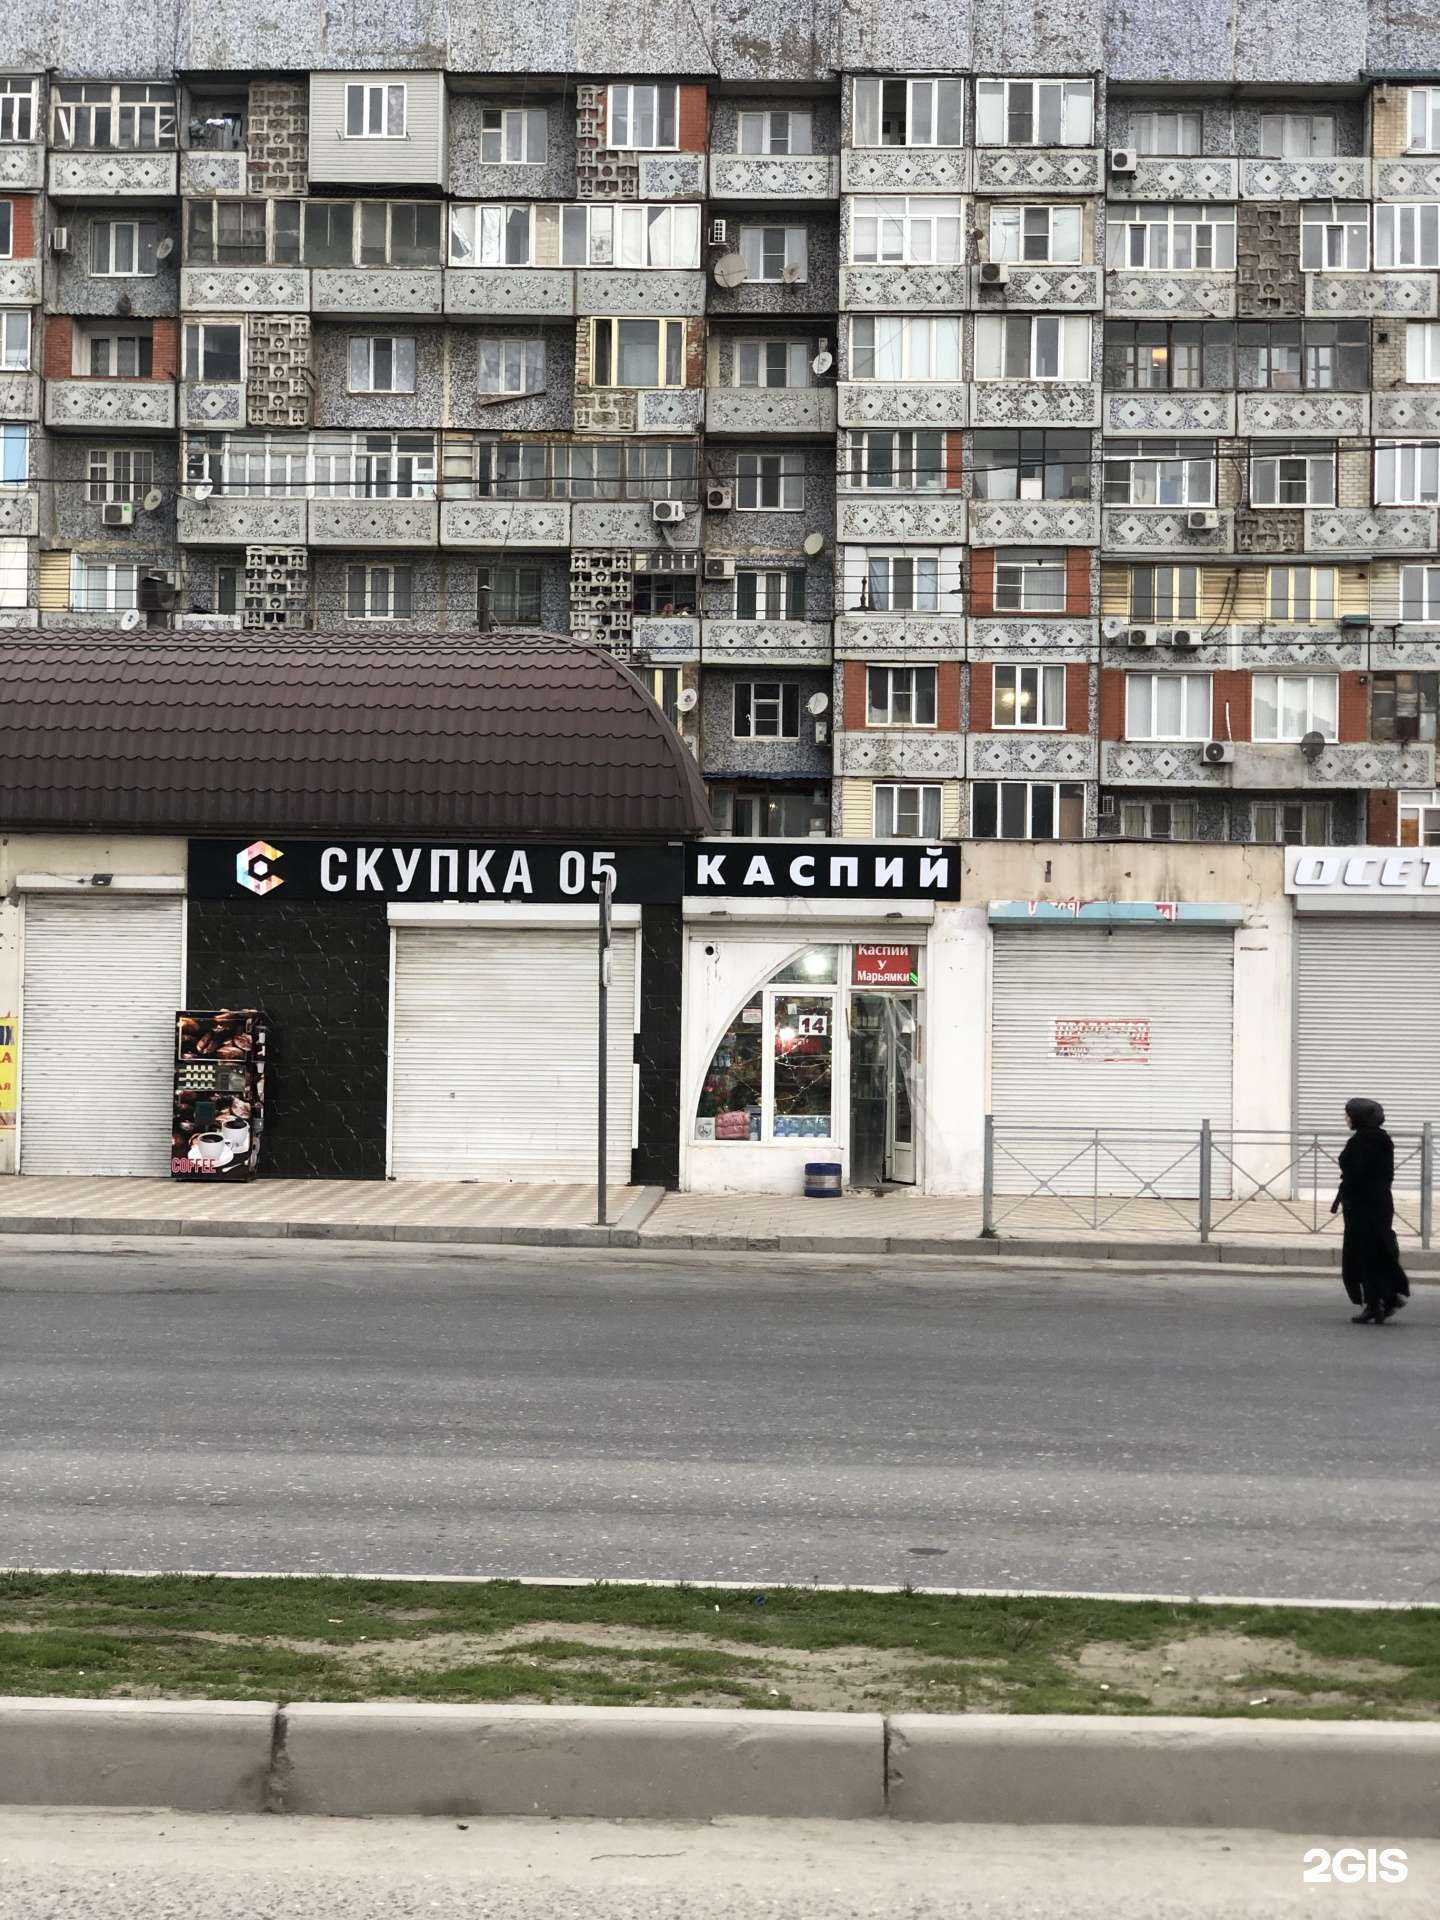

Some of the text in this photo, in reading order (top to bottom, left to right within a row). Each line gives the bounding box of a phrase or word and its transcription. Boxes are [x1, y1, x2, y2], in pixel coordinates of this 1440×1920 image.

[320, 847, 617, 895] СКУПКА 05
[697, 847, 949, 888] КАСПИЙ
[857, 970, 910, 983] Марьямки
[801, 1017, 825, 1034] 14
[171, 1157, 217, 1174] COFFEE
